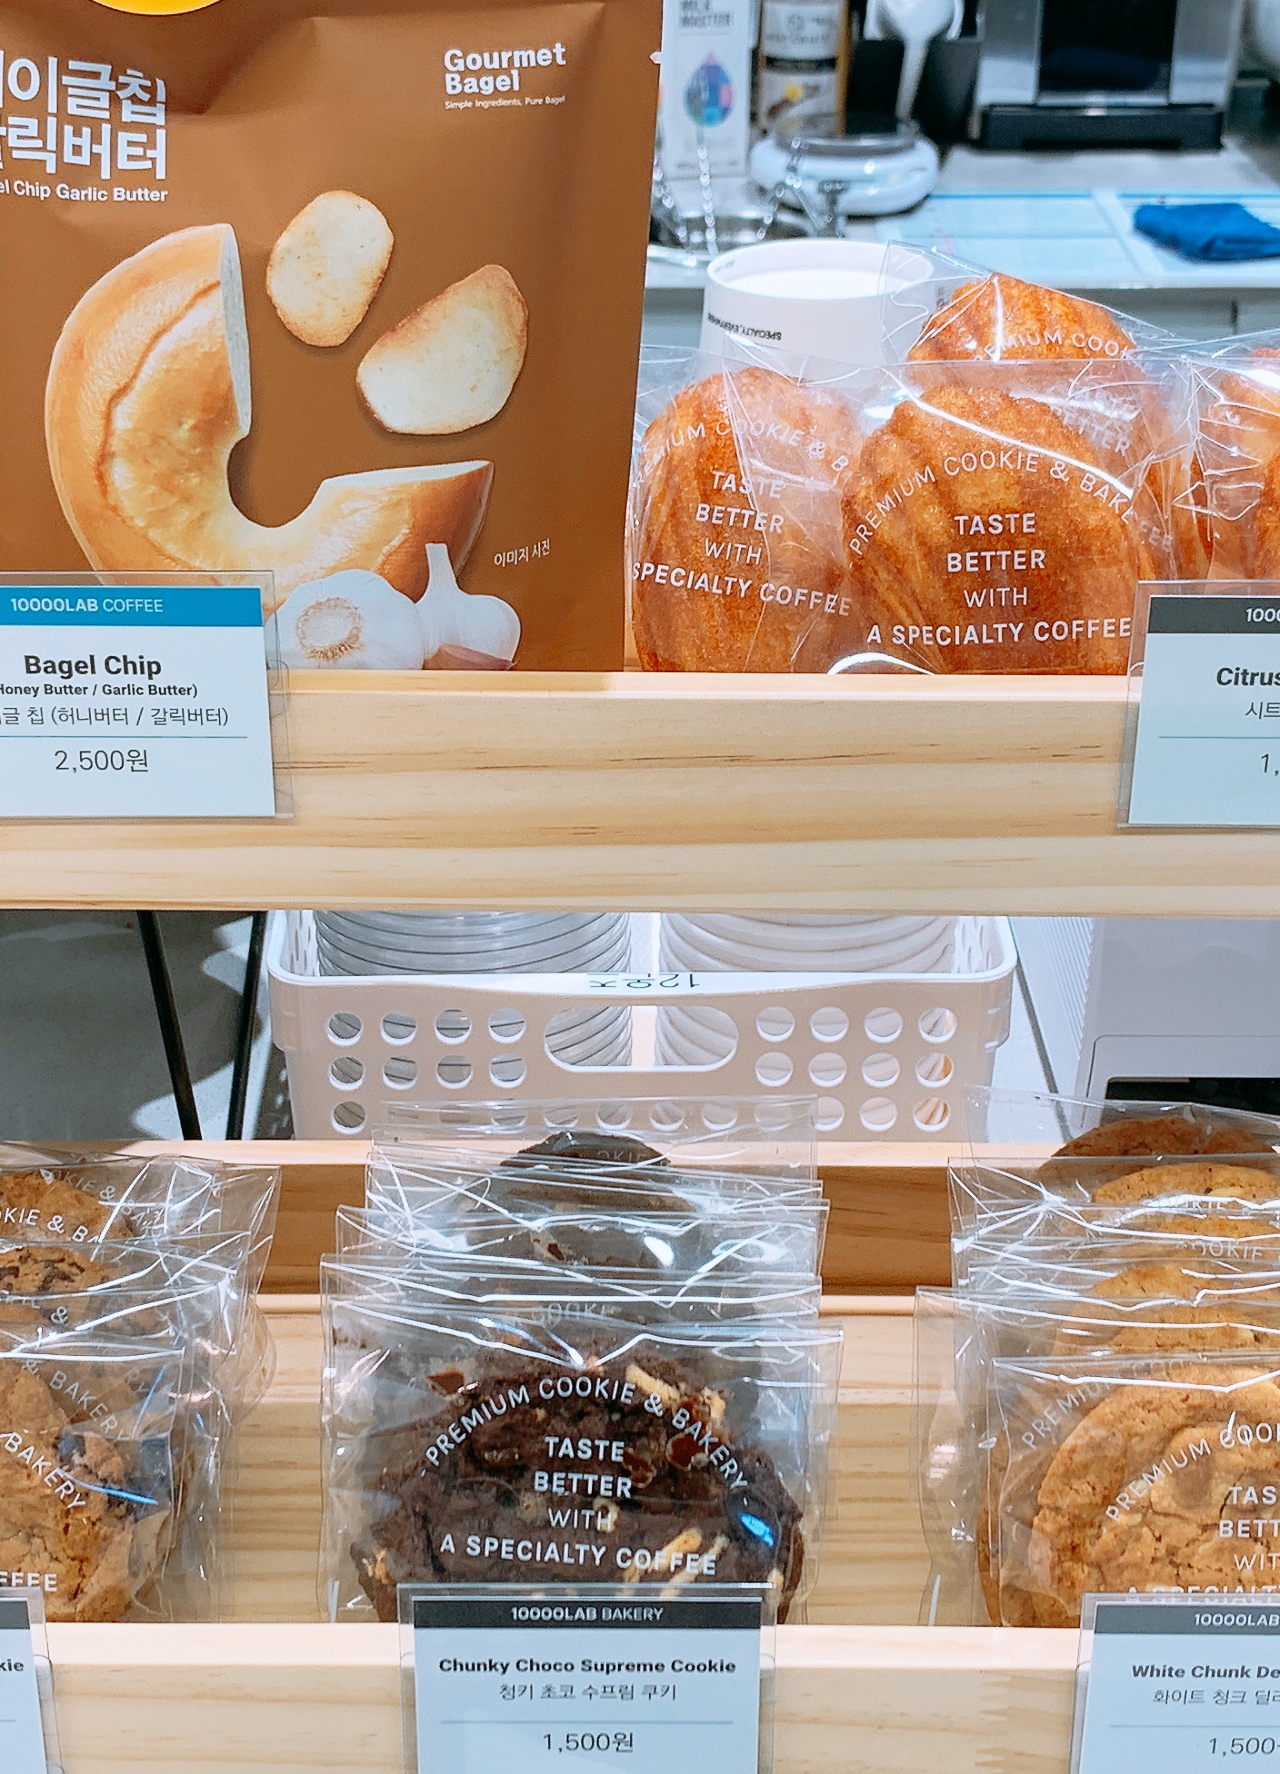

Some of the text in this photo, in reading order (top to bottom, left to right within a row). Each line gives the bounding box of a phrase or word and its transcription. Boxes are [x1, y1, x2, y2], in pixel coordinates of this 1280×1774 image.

[444, 42, 566, 71] Gourmet
[445, 69, 520, 95] Bagel
[445, 101, 472, 110] Simple
[525, 97, 543, 105] Pure
[13, 180, 51, 200] Chip
[56, 183, 108, 201] Garlic
[113, 187, 168, 202] Butter
[711, 470, 787, 499] TASTE
[849, 450, 1070, 555] PREMIUM COOKIE &
[695, 503, 785, 534] BETTER
[954, 512, 1036, 535] TASTE
[494, 537, 550, 567] 이미지 사진
[704, 538, 762, 566] WITH
[947, 549, 1046, 573] BETTER
[10, 598, 163, 613] 10000LAB COFFEE
[760, 583, 853, 617] COFFEE
[964, 587, 1028, 609] WITH
[866, 617, 1132, 646] A SPECIALTY COFFEE
[24, 655, 162, 680] Bagel Chip
[44, 684, 88, 696] Butter
[102, 684, 144, 696] Garlic
[148, 684, 198, 698] Butter)
[27, 706, 45, 725] 칩
[51, 706, 129, 726] (허니버터
[151, 706, 229, 726] 갈릭버터)
[54, 749, 149, 773] 2,500원
[426, 1376, 748, 1491] PREMIUM COOKIE & BAKERY
[544, 1436, 624, 1462] TASTE
[4, 1431, 87, 1512] BAKERY
[1105, 1438, 1211, 1522] PREMIUM
[534, 1471, 632, 1499] BETTER
[547, 1507, 612, 1531] WITH
[440, 1534, 717, 1576] A SPECIALTY COFFEE
[511, 1607, 664, 1621] 10000LAB BAKERY
[1194, 1613, 1280, 1627] 10000LAB
[438, 1658, 736, 1675] Chunky Choco Supreme Cookie
[1132, 1664, 1186, 1679] White
[1191, 1664, 1251, 1679] Chunk
[540, 1684, 677, 1700] 초코 수프림 쿠키
[1153, 1689, 1205, 1705] 화이트
[1213, 1689, 1247, 1705] 청크
[542, 1732, 634, 1753] 1,500원
